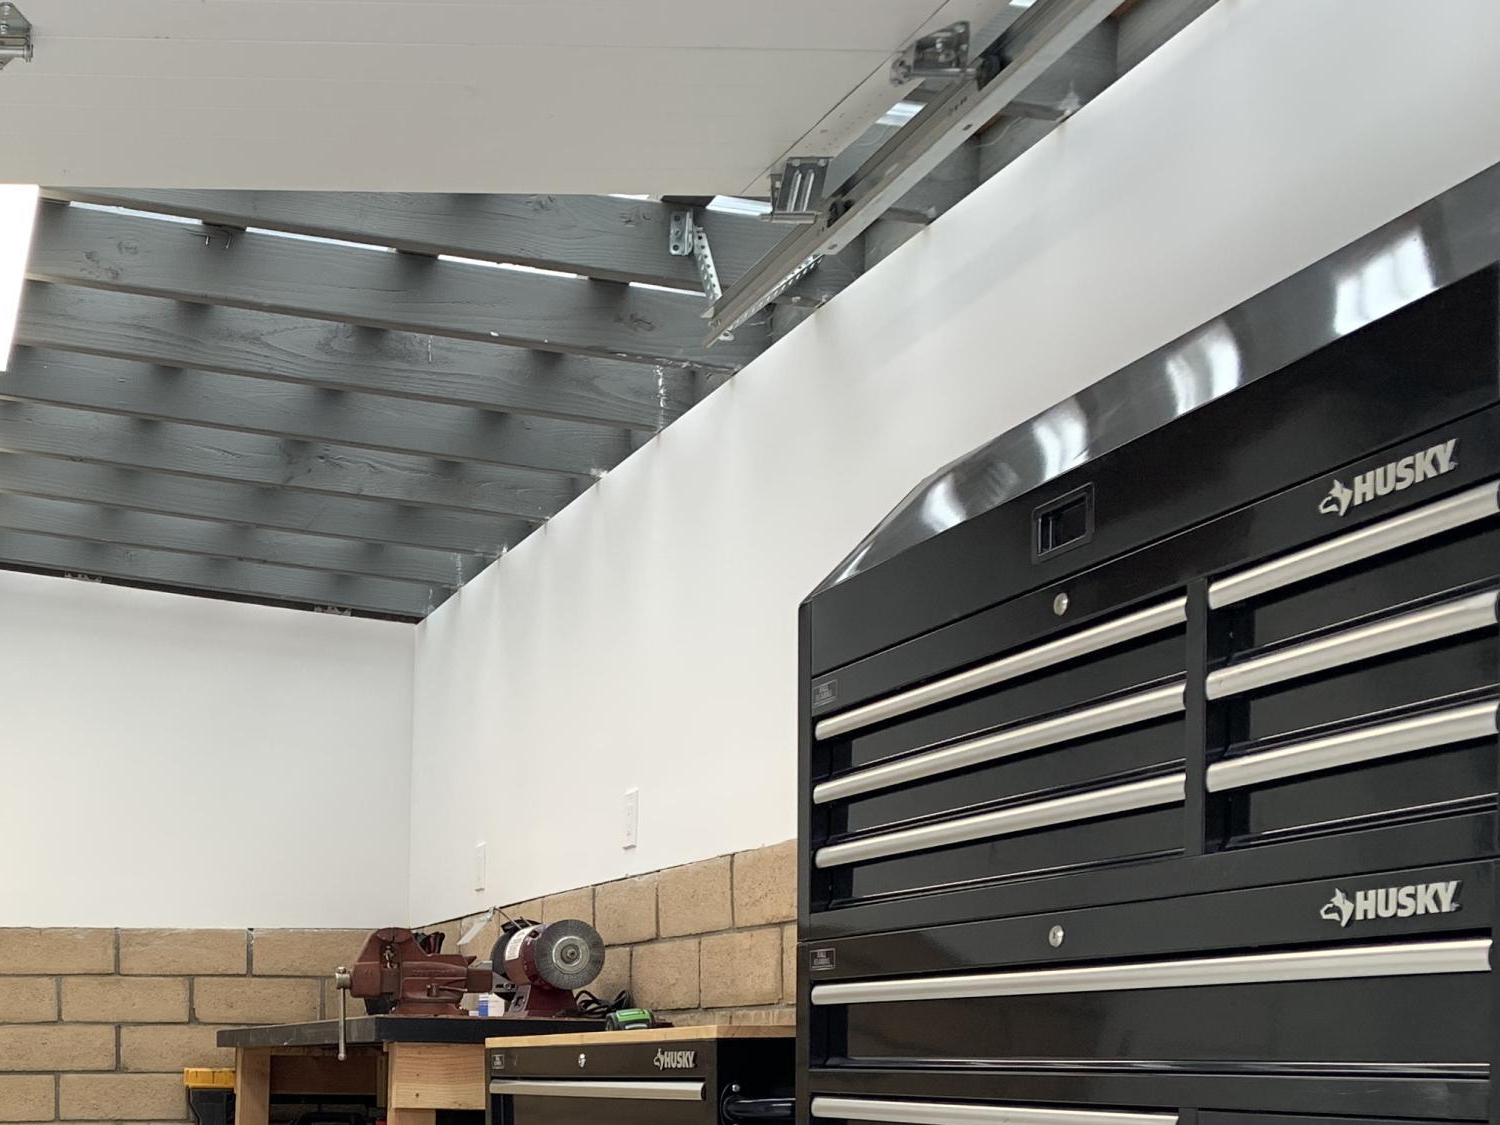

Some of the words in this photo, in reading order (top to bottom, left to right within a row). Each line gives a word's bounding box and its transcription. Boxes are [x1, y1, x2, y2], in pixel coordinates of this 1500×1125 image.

[1353, 438, 1457, 506] HUSKY
[1355, 880, 1460, 920] HUSKY
[664, 1050, 696, 1069] HUSKY
